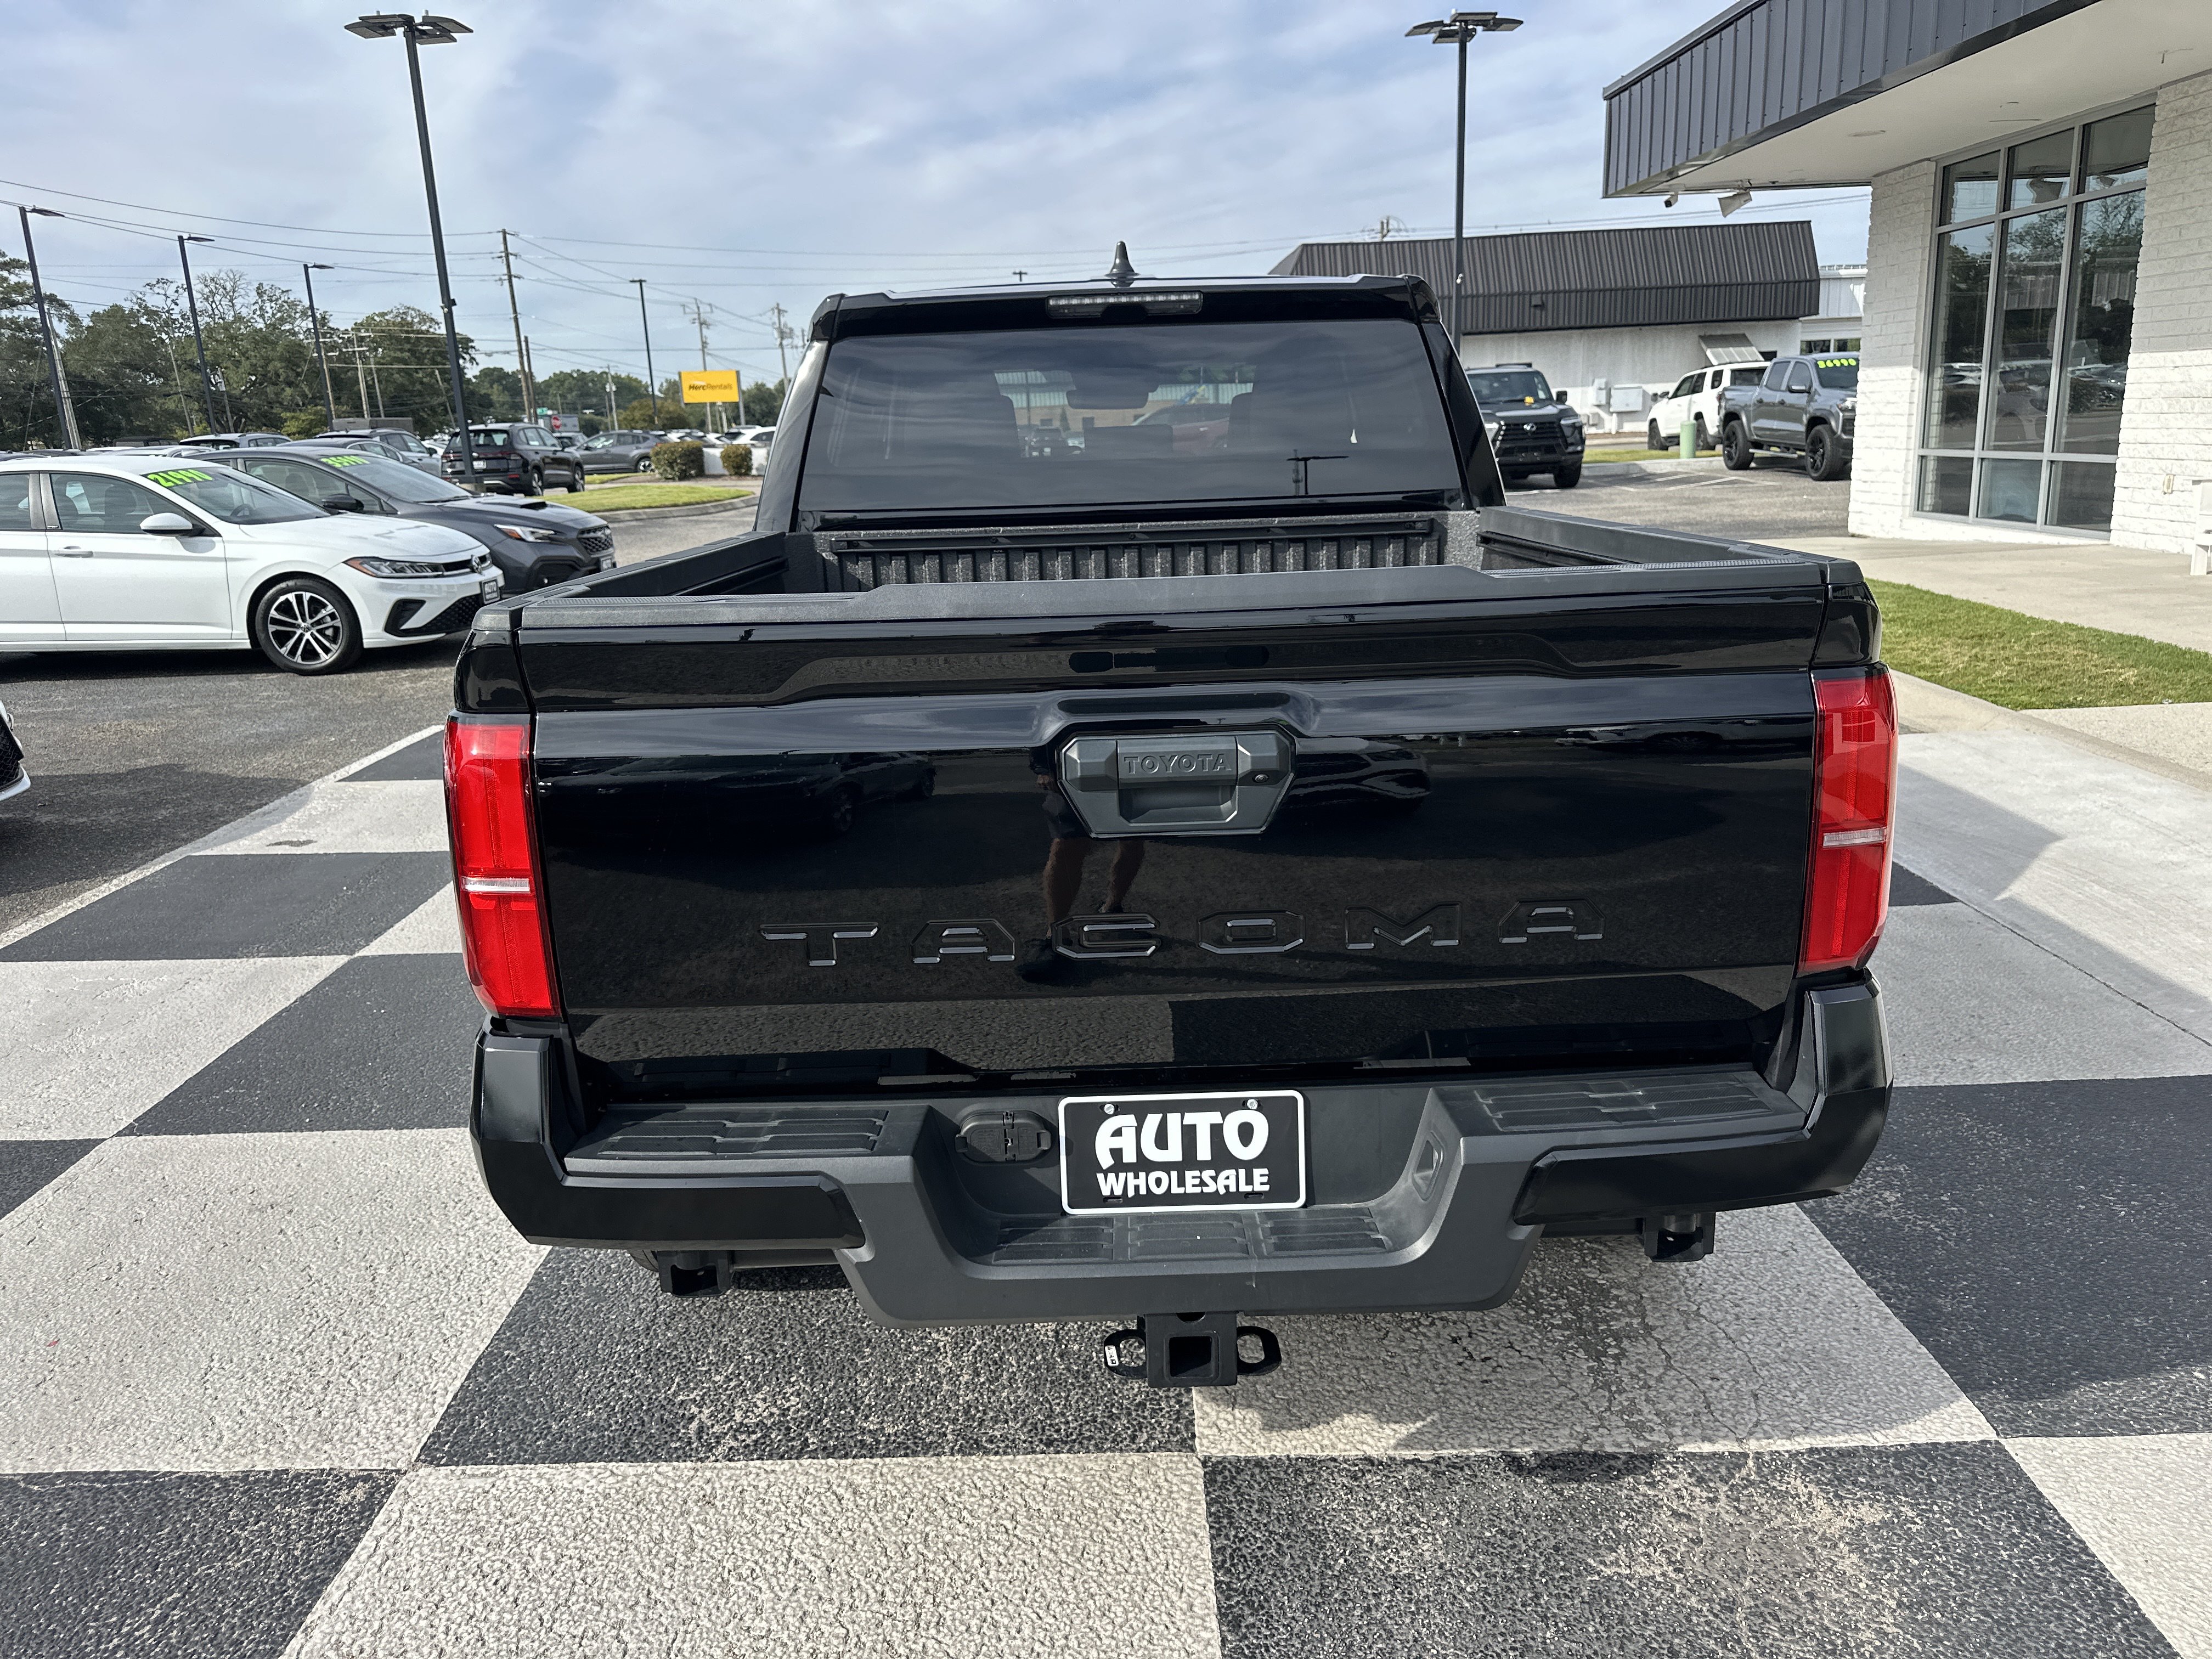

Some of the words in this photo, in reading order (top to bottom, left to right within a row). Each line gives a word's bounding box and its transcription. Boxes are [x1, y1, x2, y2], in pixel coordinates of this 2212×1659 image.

[147, 469, 213, 487] 21990
[1124, 753, 1232, 775] TOYOTA
[760, 896, 1605, 966] TACOMA
[1095, 1109, 1269, 1171] AUTO
[1096, 1168, 1271, 1198] WHOLESALE
